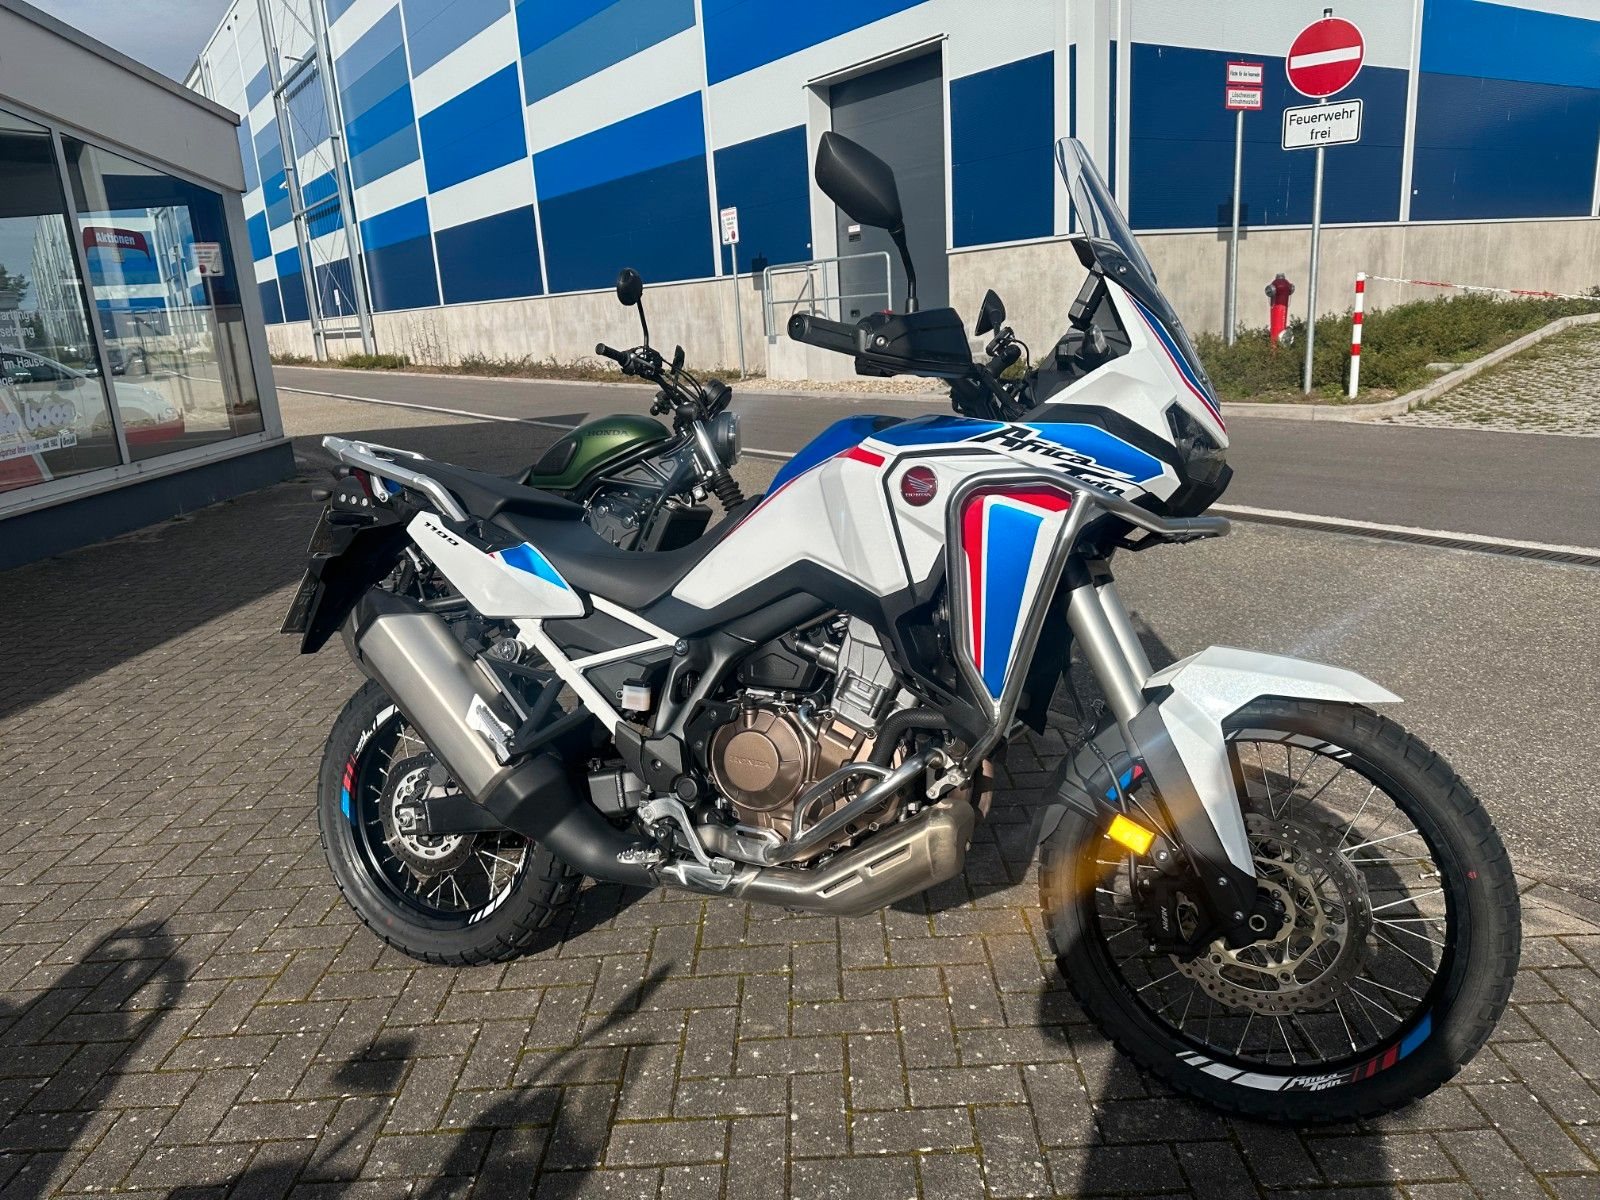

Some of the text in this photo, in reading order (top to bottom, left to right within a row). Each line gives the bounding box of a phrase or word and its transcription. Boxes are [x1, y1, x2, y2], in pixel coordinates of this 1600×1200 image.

[1289, 108, 1355, 126] Feuerwehr
[1310, 127, 1331, 140] frei
[95, 232, 136, 245] Aktionen
[2, 356, 45, 369] im Hause
[586, 429, 630, 437] HONDA
[971, 424, 1094, 467] Africa
[424, 521, 459, 546] 1100
[728, 754, 771, 769] HONDA
[1283, 1073, 1340, 1091] Africa
[1305, 1079, 1343, 1092] Twin
